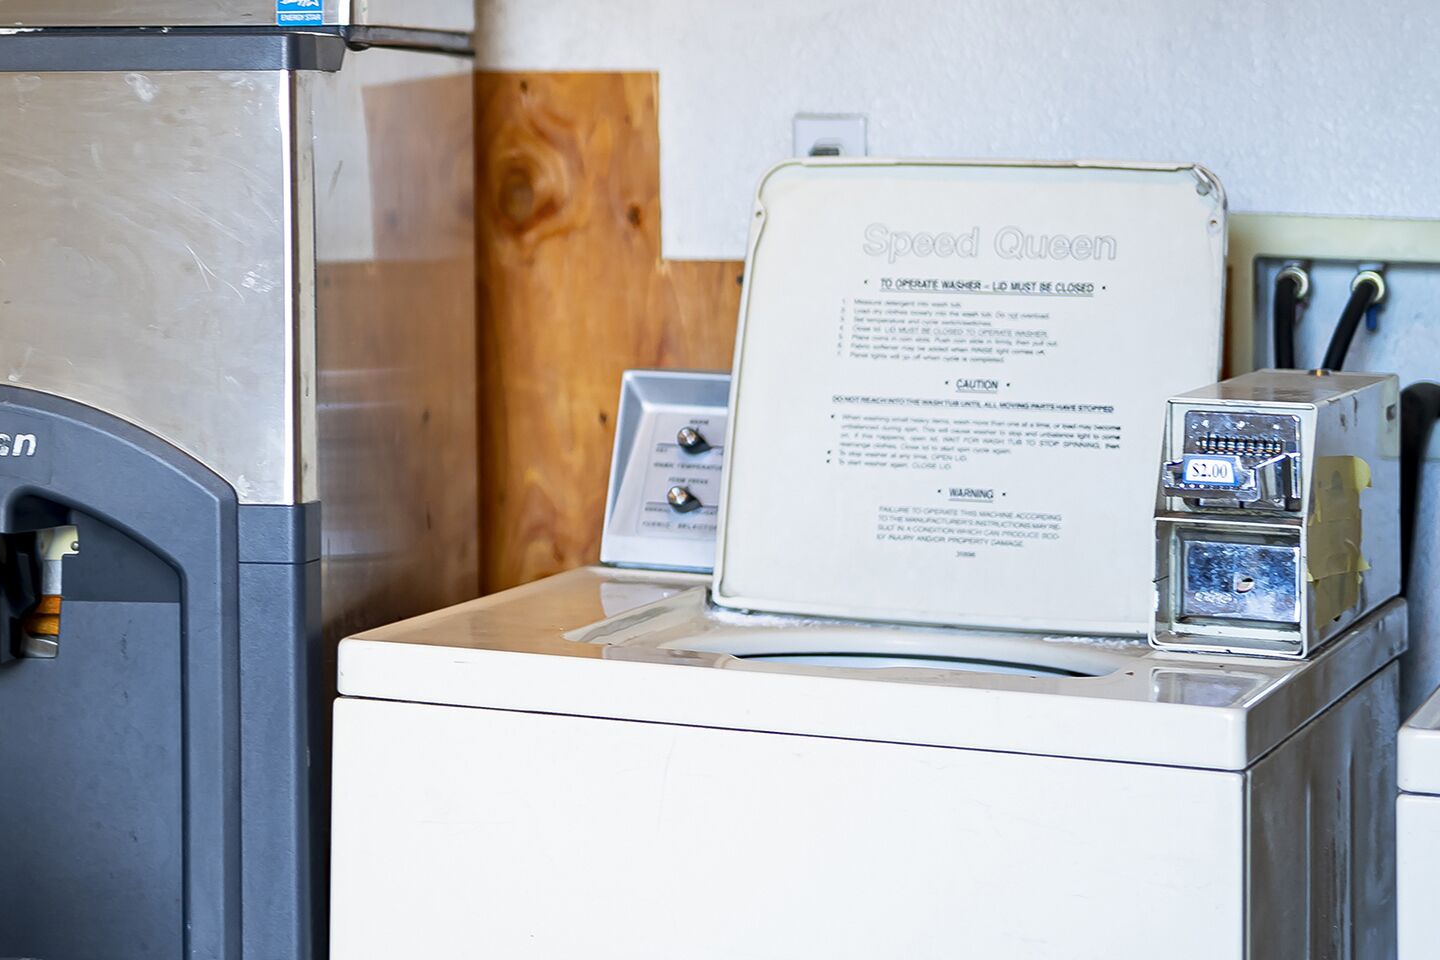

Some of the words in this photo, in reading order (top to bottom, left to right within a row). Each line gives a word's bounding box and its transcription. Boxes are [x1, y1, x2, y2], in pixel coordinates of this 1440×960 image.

[863, 222, 980, 264] Speed
[994, 225, 1117, 261] Queen
[880, 278, 893, 288] TO
[894, 278, 939, 290] OPERATE
[940, 280, 982, 291] WASHER
[992, 281, 1008, 291] LID
[1010, 281, 1037, 292] MUST
[1040, 282, 1053, 292] BE
[1054, 283, 1095, 294] CLOSED
[956, 378, 998, 389] CAUTION
[949, 487, 994, 499] WARNING
